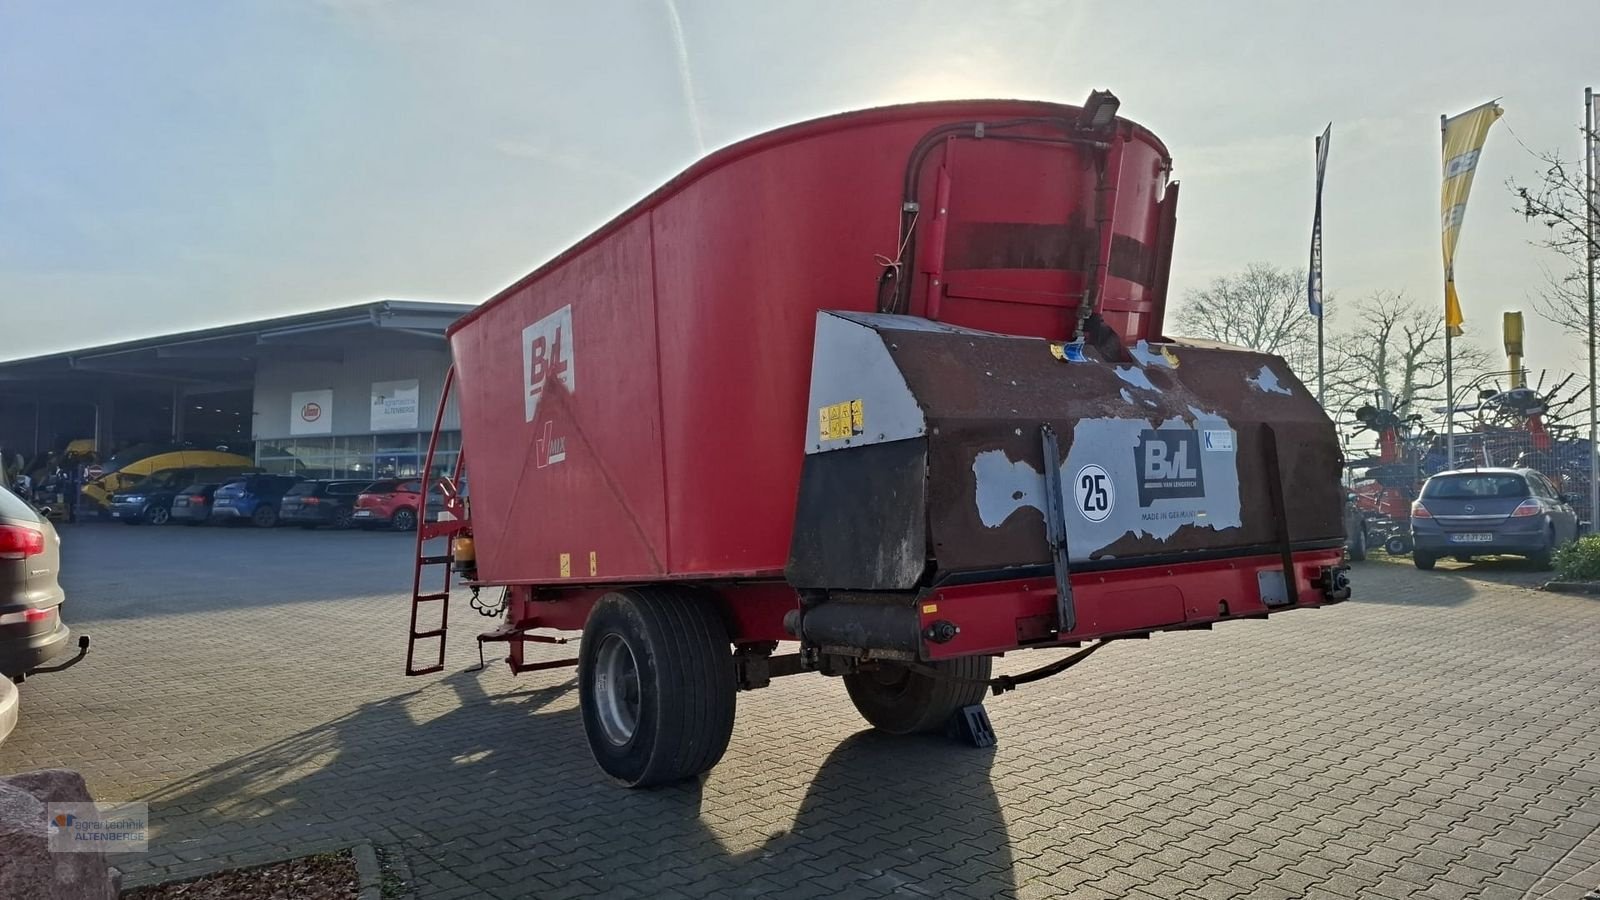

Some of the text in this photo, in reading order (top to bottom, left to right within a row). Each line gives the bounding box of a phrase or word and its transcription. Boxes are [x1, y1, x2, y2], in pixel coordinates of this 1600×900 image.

[1204, 431, 1213, 449] K
[1082, 475, 1108, 512] 25
[1142, 510, 1196, 520] MADE IN GERMANY
